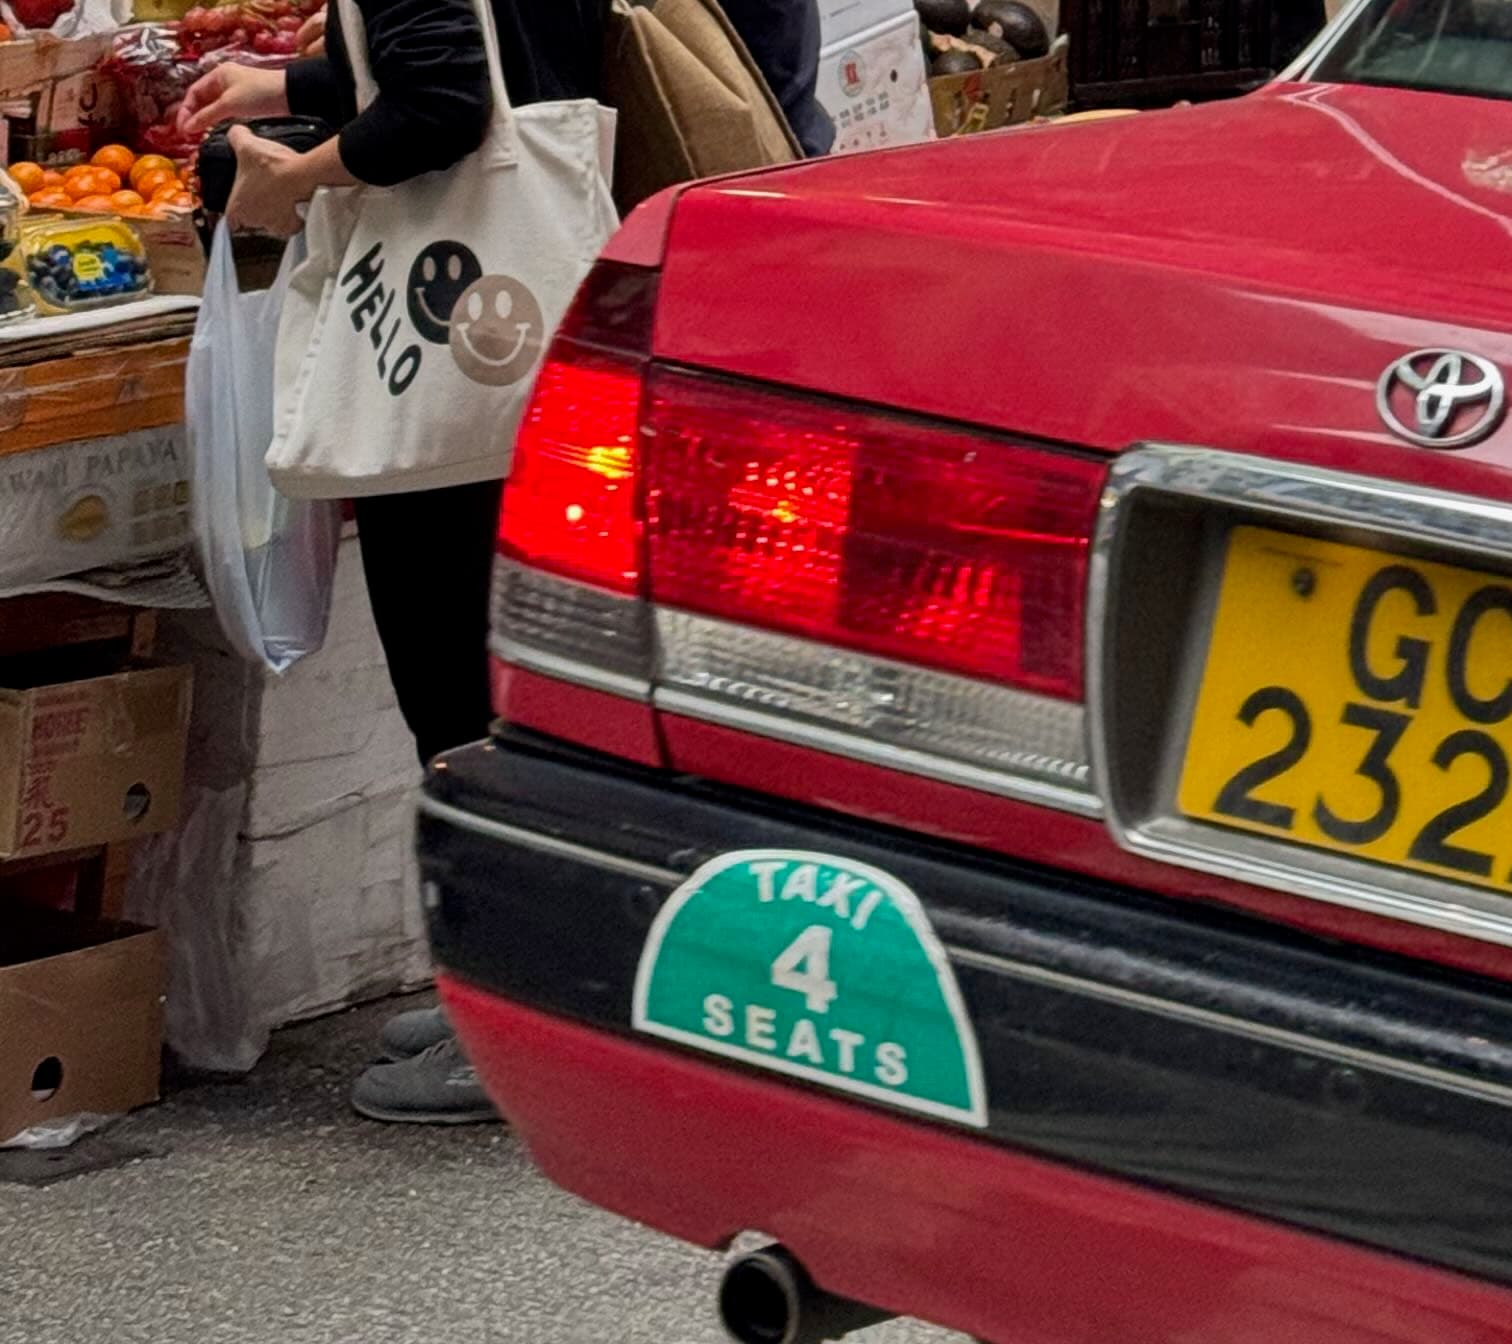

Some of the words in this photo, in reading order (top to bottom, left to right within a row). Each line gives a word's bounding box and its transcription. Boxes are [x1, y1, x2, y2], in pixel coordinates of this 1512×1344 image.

[340, 241, 422, 396] HELLO
[85, 440, 178, 480] PAPAYA
[23, 807, 70, 848] 25
[749, 861, 884, 930] TAXI
[771, 925, 837, 1014] 4
[703, 994, 909, 1086] SEATS
